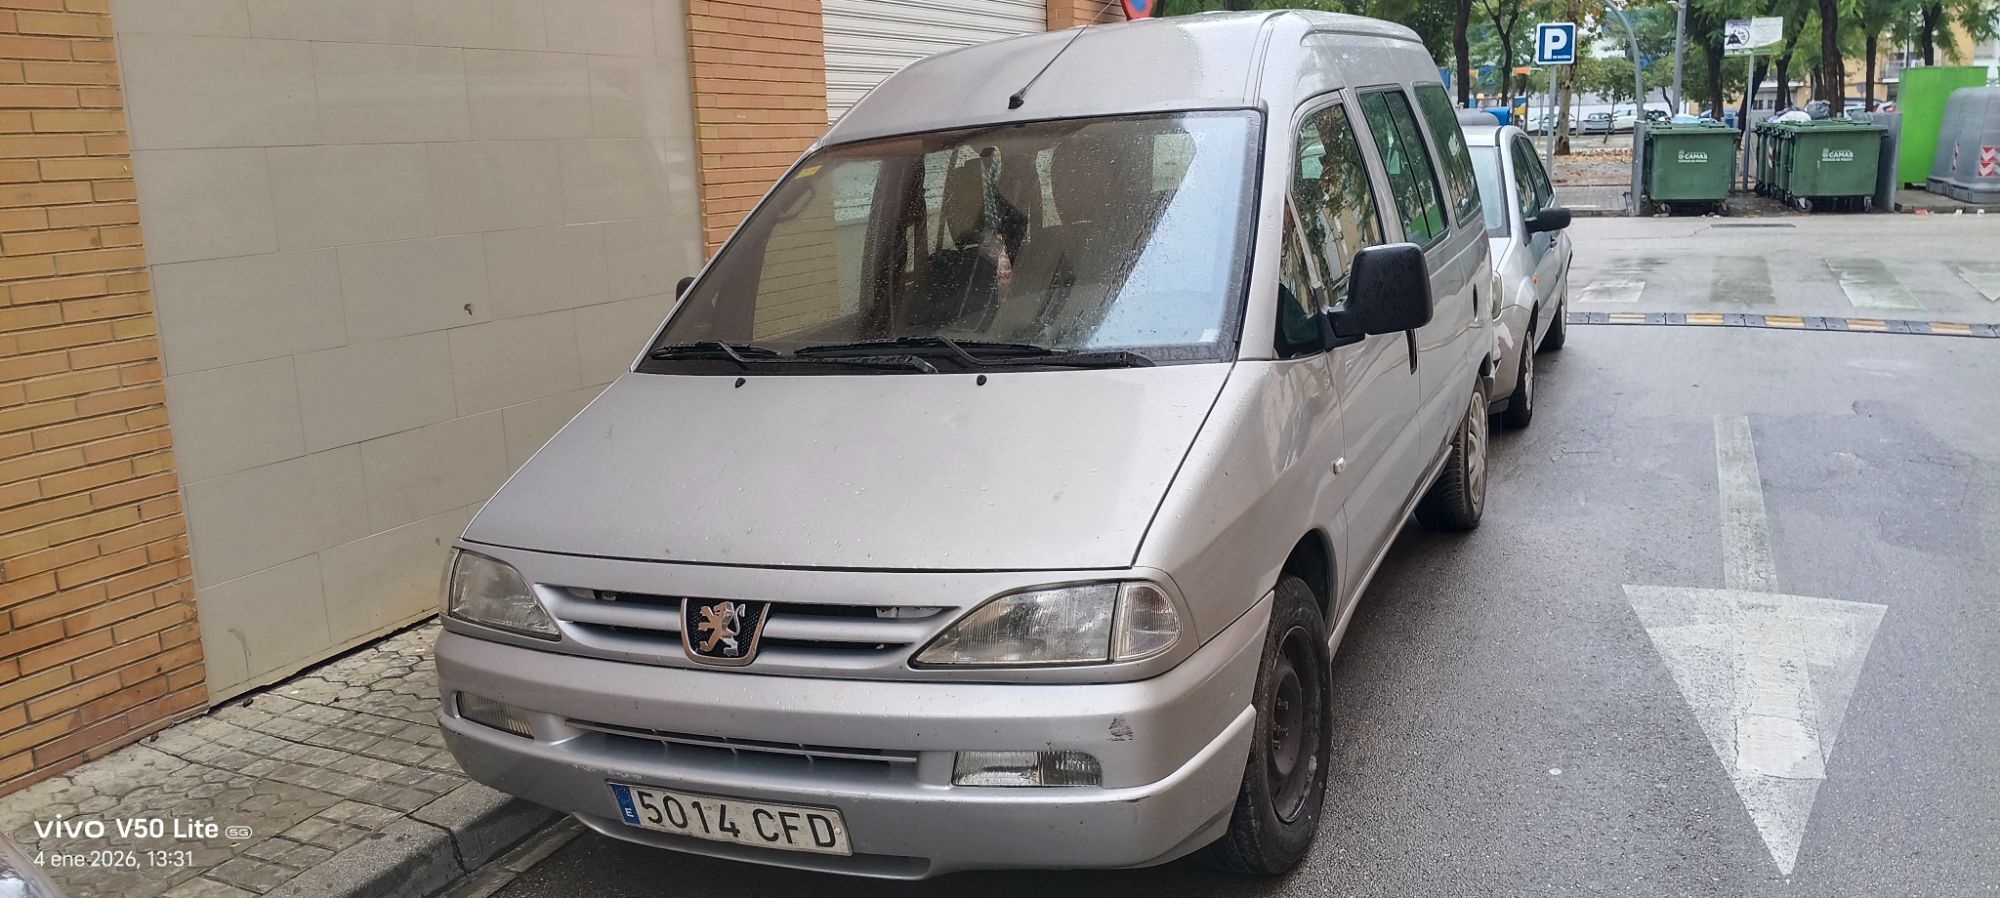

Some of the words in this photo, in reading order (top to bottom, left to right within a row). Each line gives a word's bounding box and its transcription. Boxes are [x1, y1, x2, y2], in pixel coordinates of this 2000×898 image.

[1544, 28, 1568, 60] P
[625, 807, 635, 818] E
[637, 790, 740, 838] 5014
[752, 808, 837, 848] CFD
